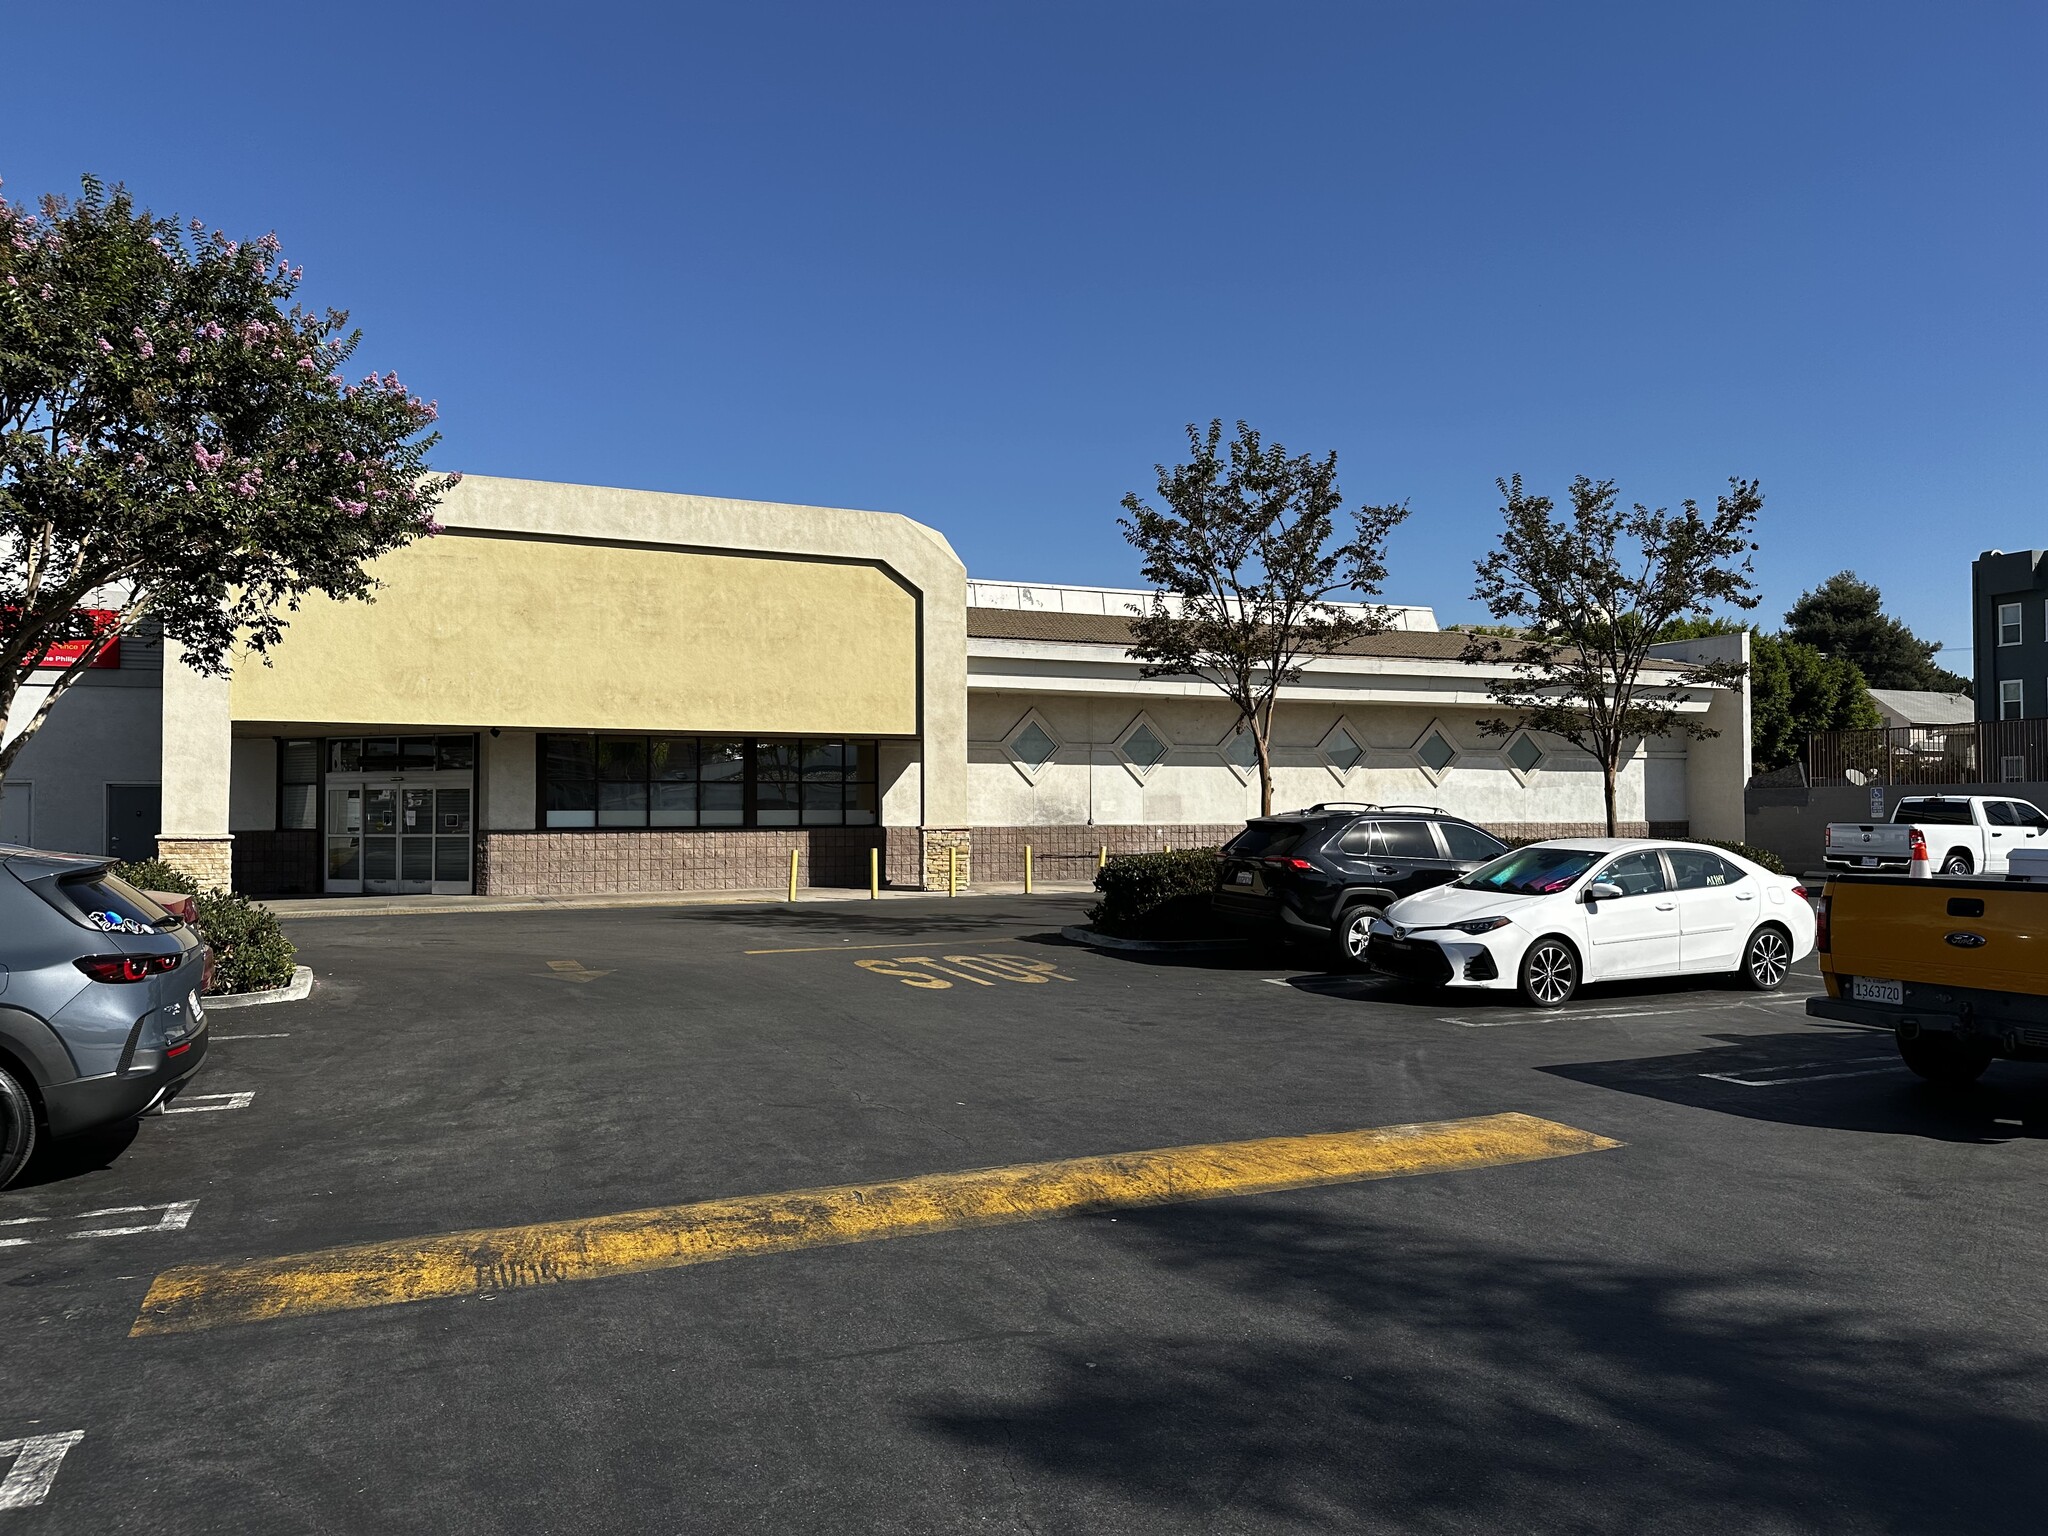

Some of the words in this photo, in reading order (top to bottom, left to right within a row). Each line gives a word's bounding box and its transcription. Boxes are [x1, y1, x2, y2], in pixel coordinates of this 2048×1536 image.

[1951, 935, 1975, 945] Ford
[854, 953, 1078, 990] STOP
[1855, 983, 1900, 1001] 1363720
